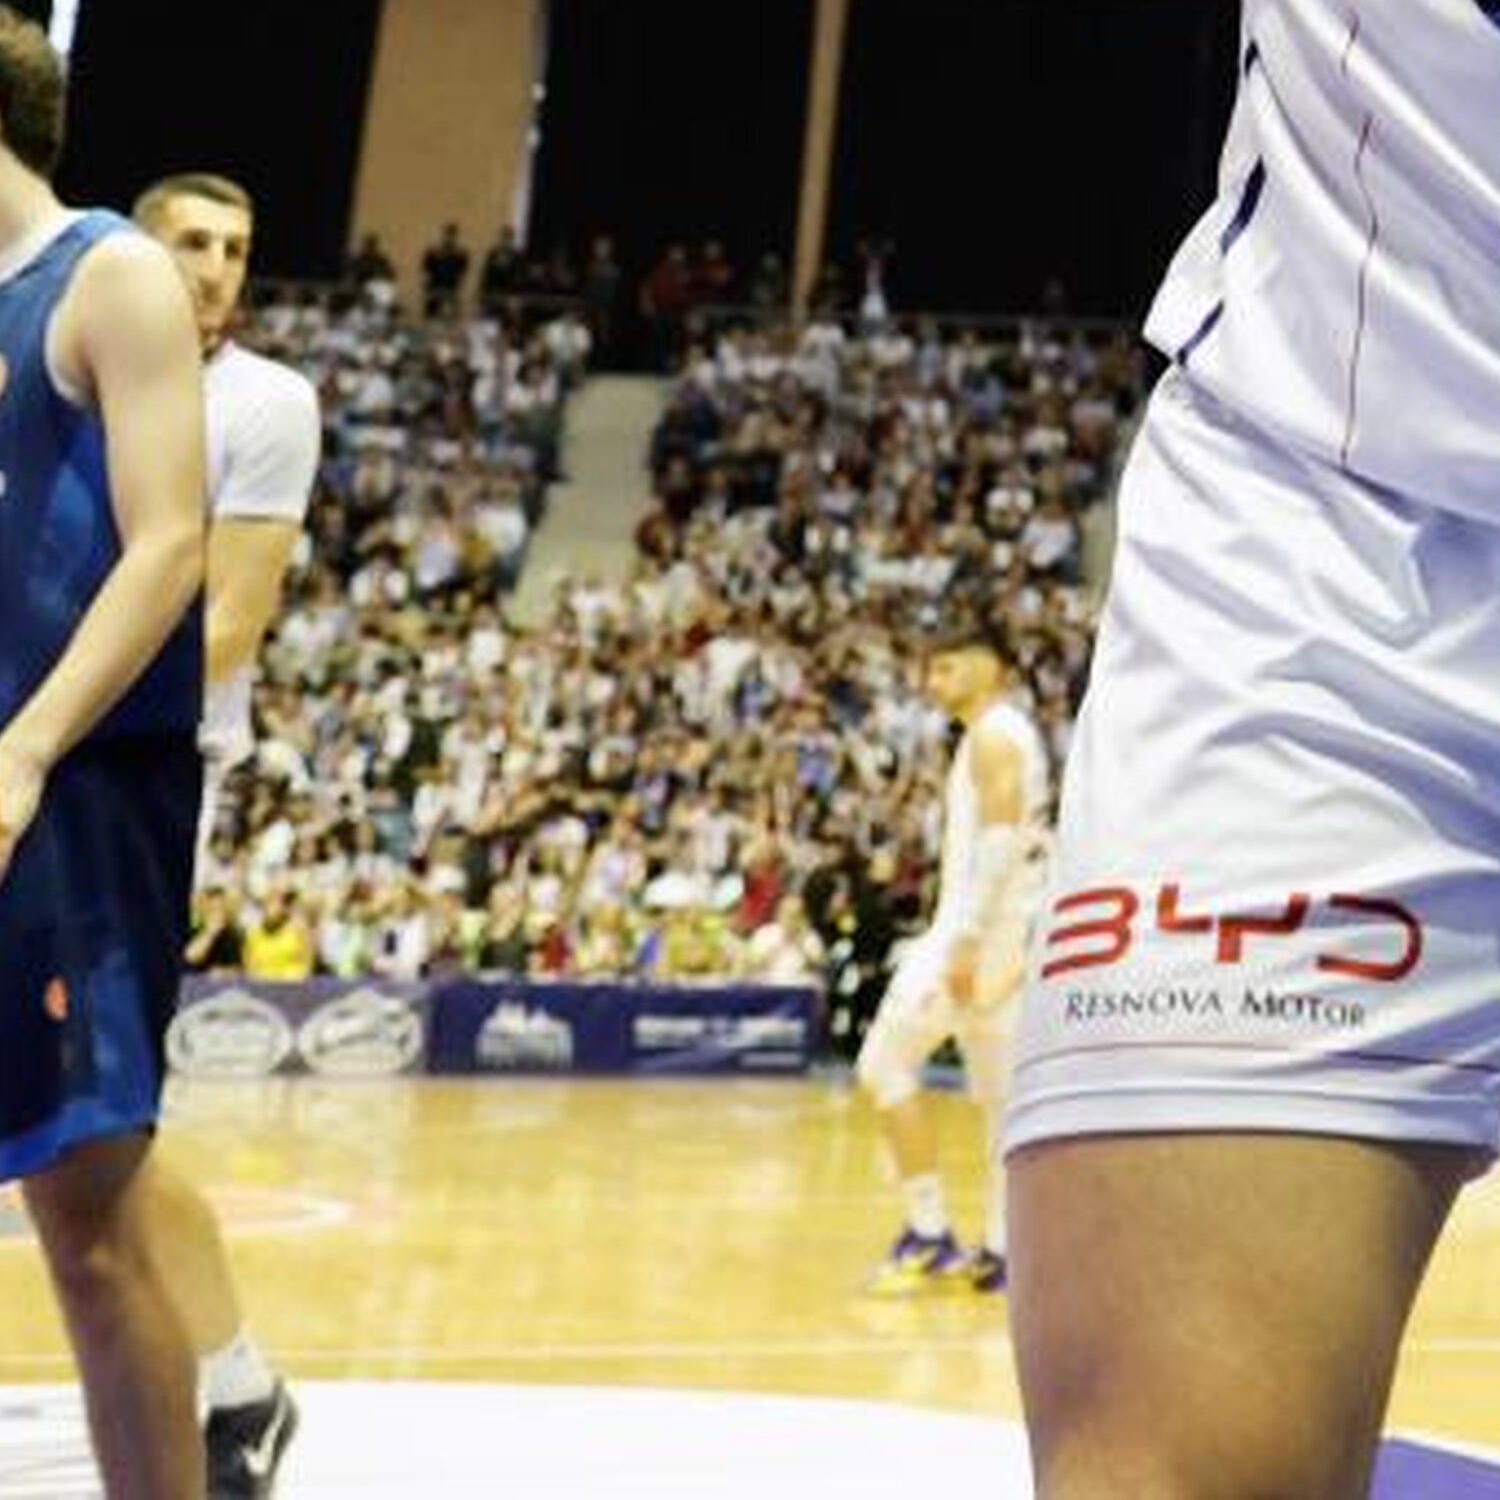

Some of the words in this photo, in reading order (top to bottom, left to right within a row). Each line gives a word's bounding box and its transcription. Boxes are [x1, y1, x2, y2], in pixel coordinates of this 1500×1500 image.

[1041, 883, 1423, 982] BYD
[1065, 987, 1223, 1025] RESNOVA
[1238, 987, 1365, 1028] MOTOR
